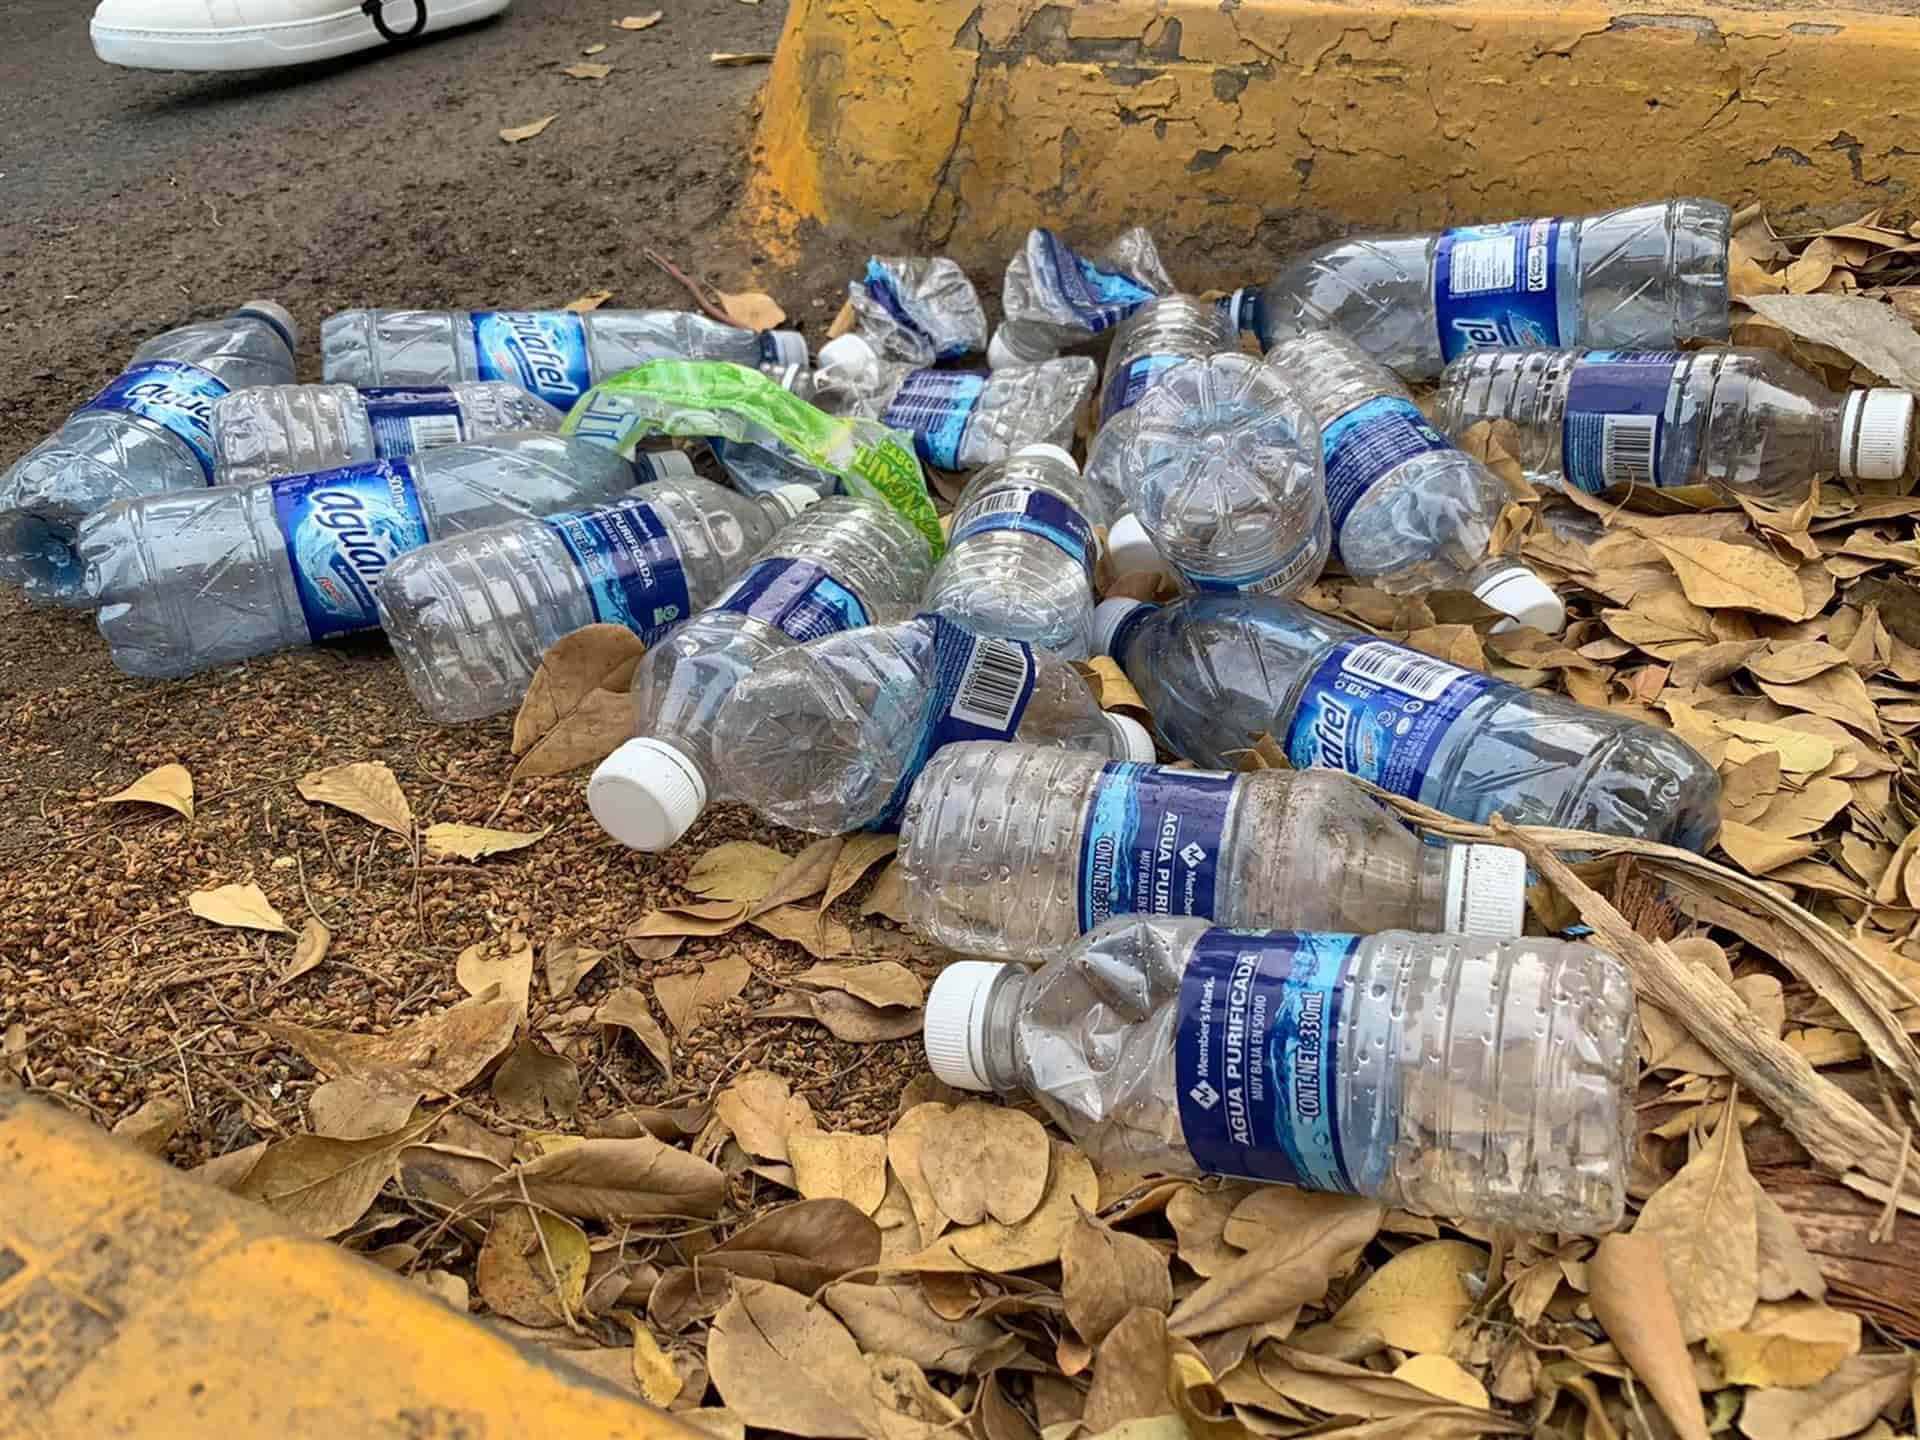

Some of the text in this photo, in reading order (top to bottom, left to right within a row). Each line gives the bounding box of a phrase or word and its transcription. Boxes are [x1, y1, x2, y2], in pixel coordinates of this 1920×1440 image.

[611, 511, 654, 589] PURIFICADA
[1154, 810, 1179, 918] AGUA PURI
[1197, 1014, 1215, 1078] Member's
[1226, 953, 1258, 1146] AGUA PURIFICADA
[1249, 994, 1267, 1101] MUY BAJA EN SODIO
